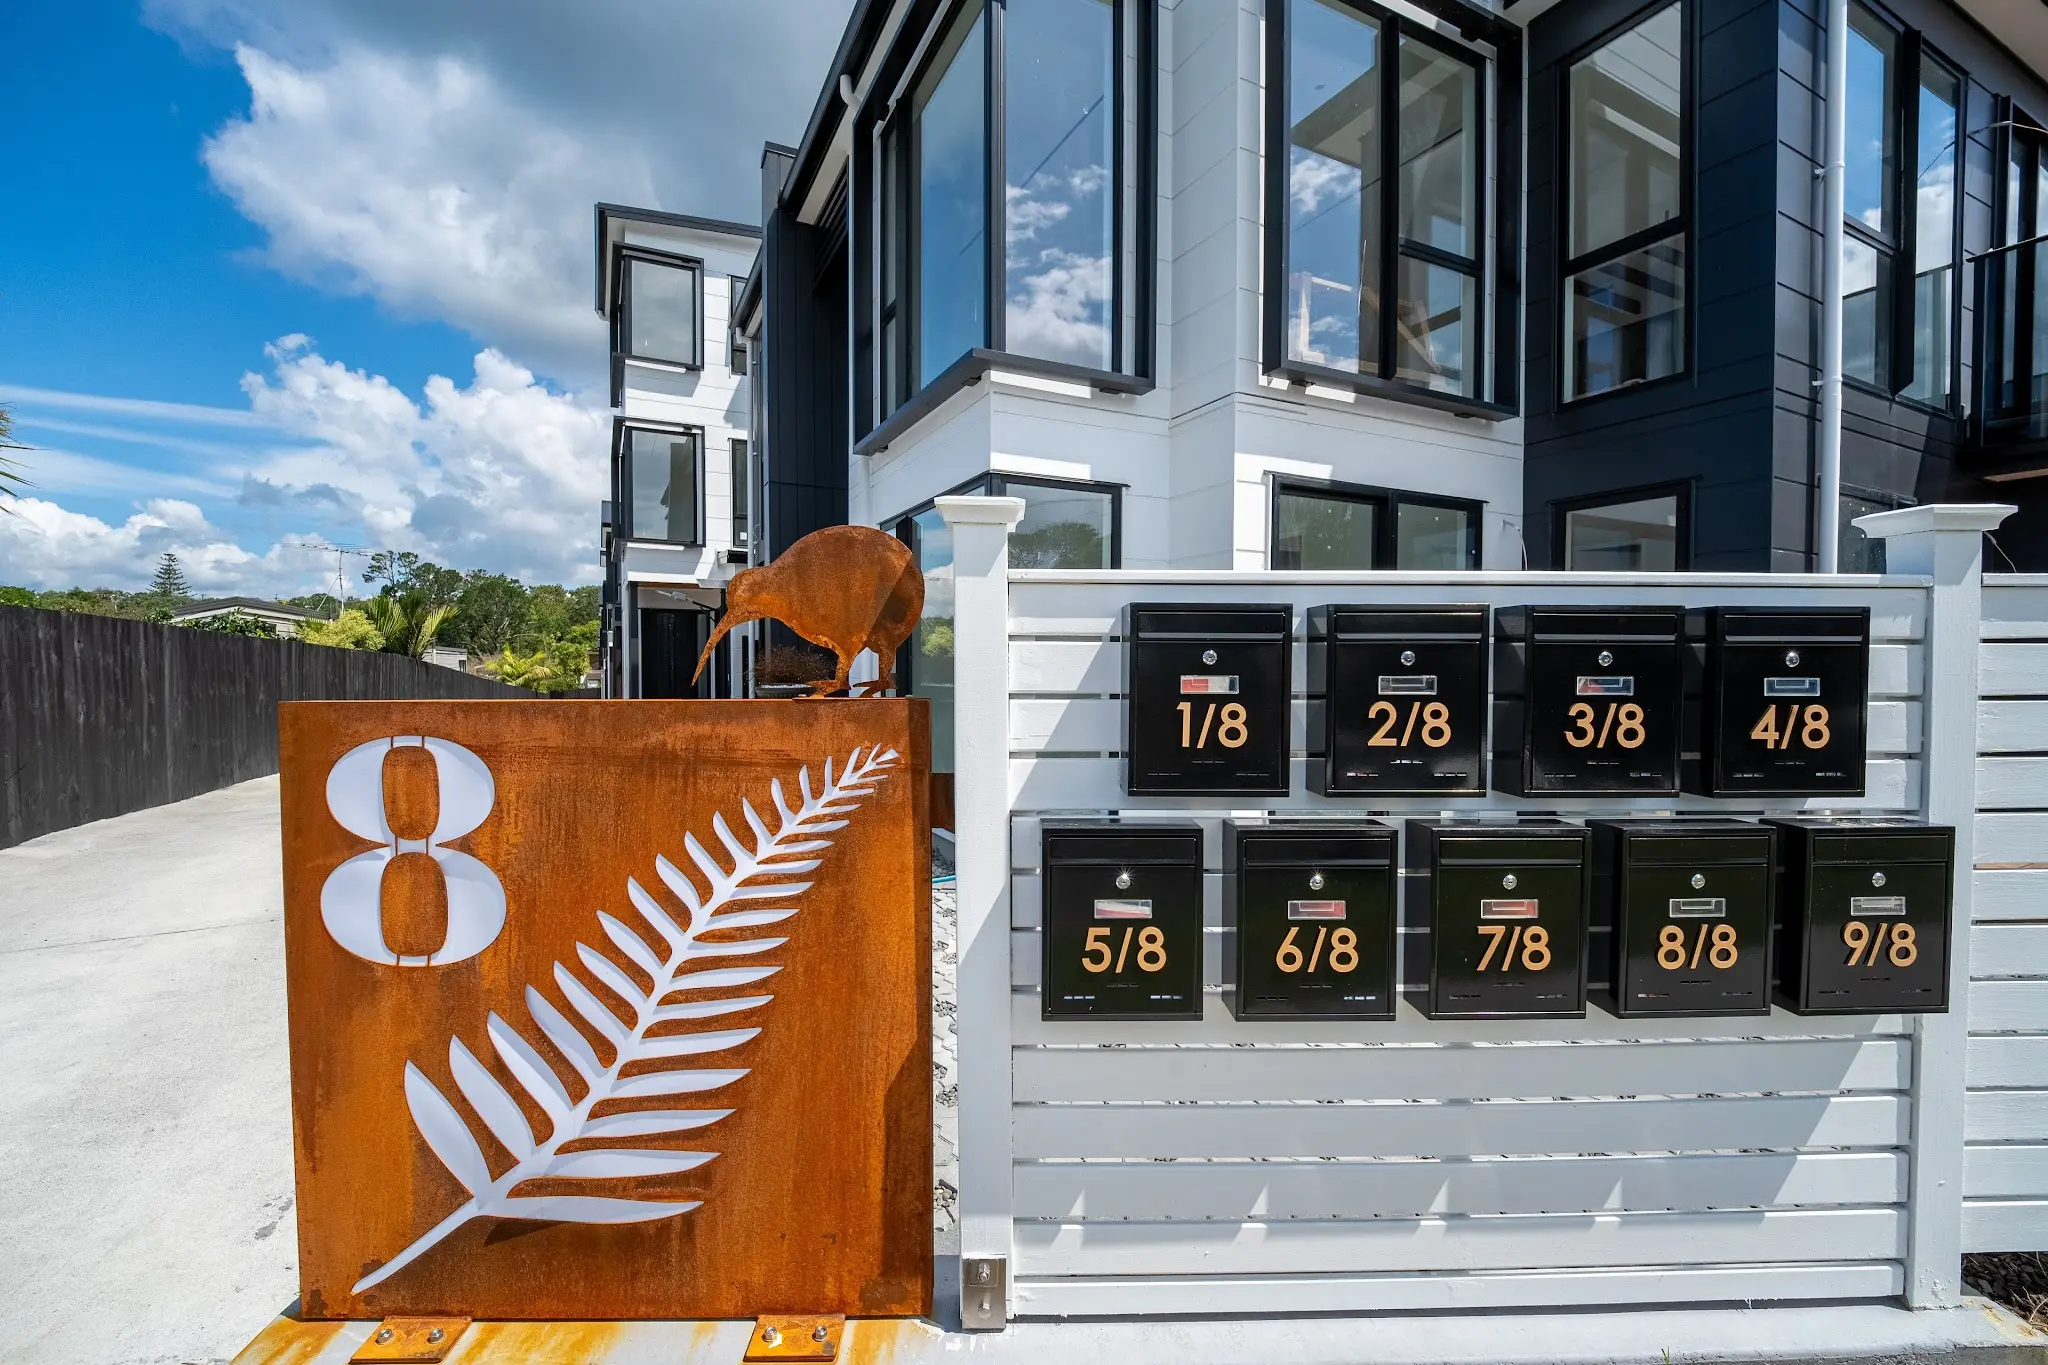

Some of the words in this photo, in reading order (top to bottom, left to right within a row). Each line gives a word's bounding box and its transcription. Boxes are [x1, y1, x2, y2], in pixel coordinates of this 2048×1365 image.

[1176, 701, 1248, 749] 1/8
[1367, 700, 1452, 748] 2/8
[1564, 702, 1646, 749] 3/8
[1750, 703, 1831, 750] 4/8
[320, 735, 507, 967] 8
[1081, 926, 1167, 974] 5/8
[1275, 926, 1359, 973] 6/8
[1476, 925, 1552, 972] 7/8
[1657, 923, 1738, 970] 8/8
[1843, 921, 1918, 967] 9/8
